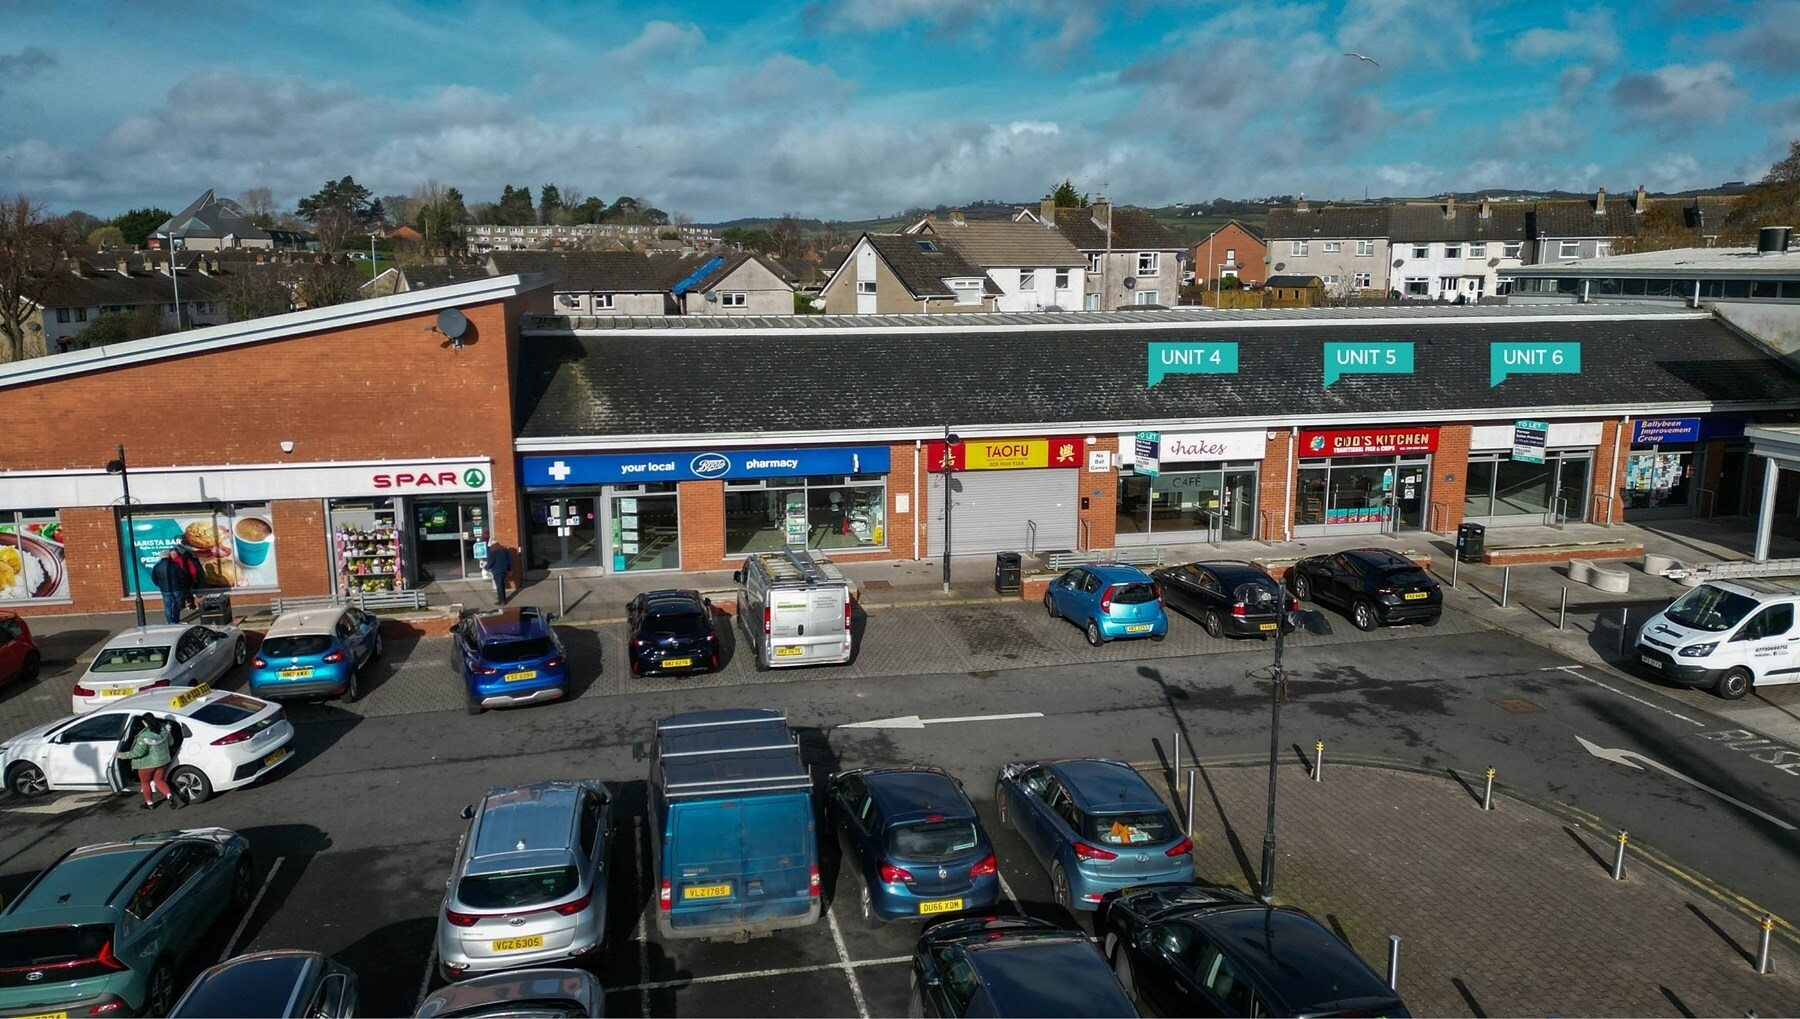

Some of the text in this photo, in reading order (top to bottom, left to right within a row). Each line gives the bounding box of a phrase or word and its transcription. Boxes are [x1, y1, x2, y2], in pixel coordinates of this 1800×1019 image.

[1641, 420, 1682, 428] Ballybeen
[1640, 427, 1692, 436] Improvement
[1376, 433, 1430, 446] KITCHEN
[1637, 435, 1664, 443] Group
[985, 444, 1029, 458] TAOFU
[621, 461, 675, 475] your local
[746, 458, 798, 470] pharmacy
[372, 472, 458, 489] SPAR
[496, 938, 539, 950] VGZ 6305
